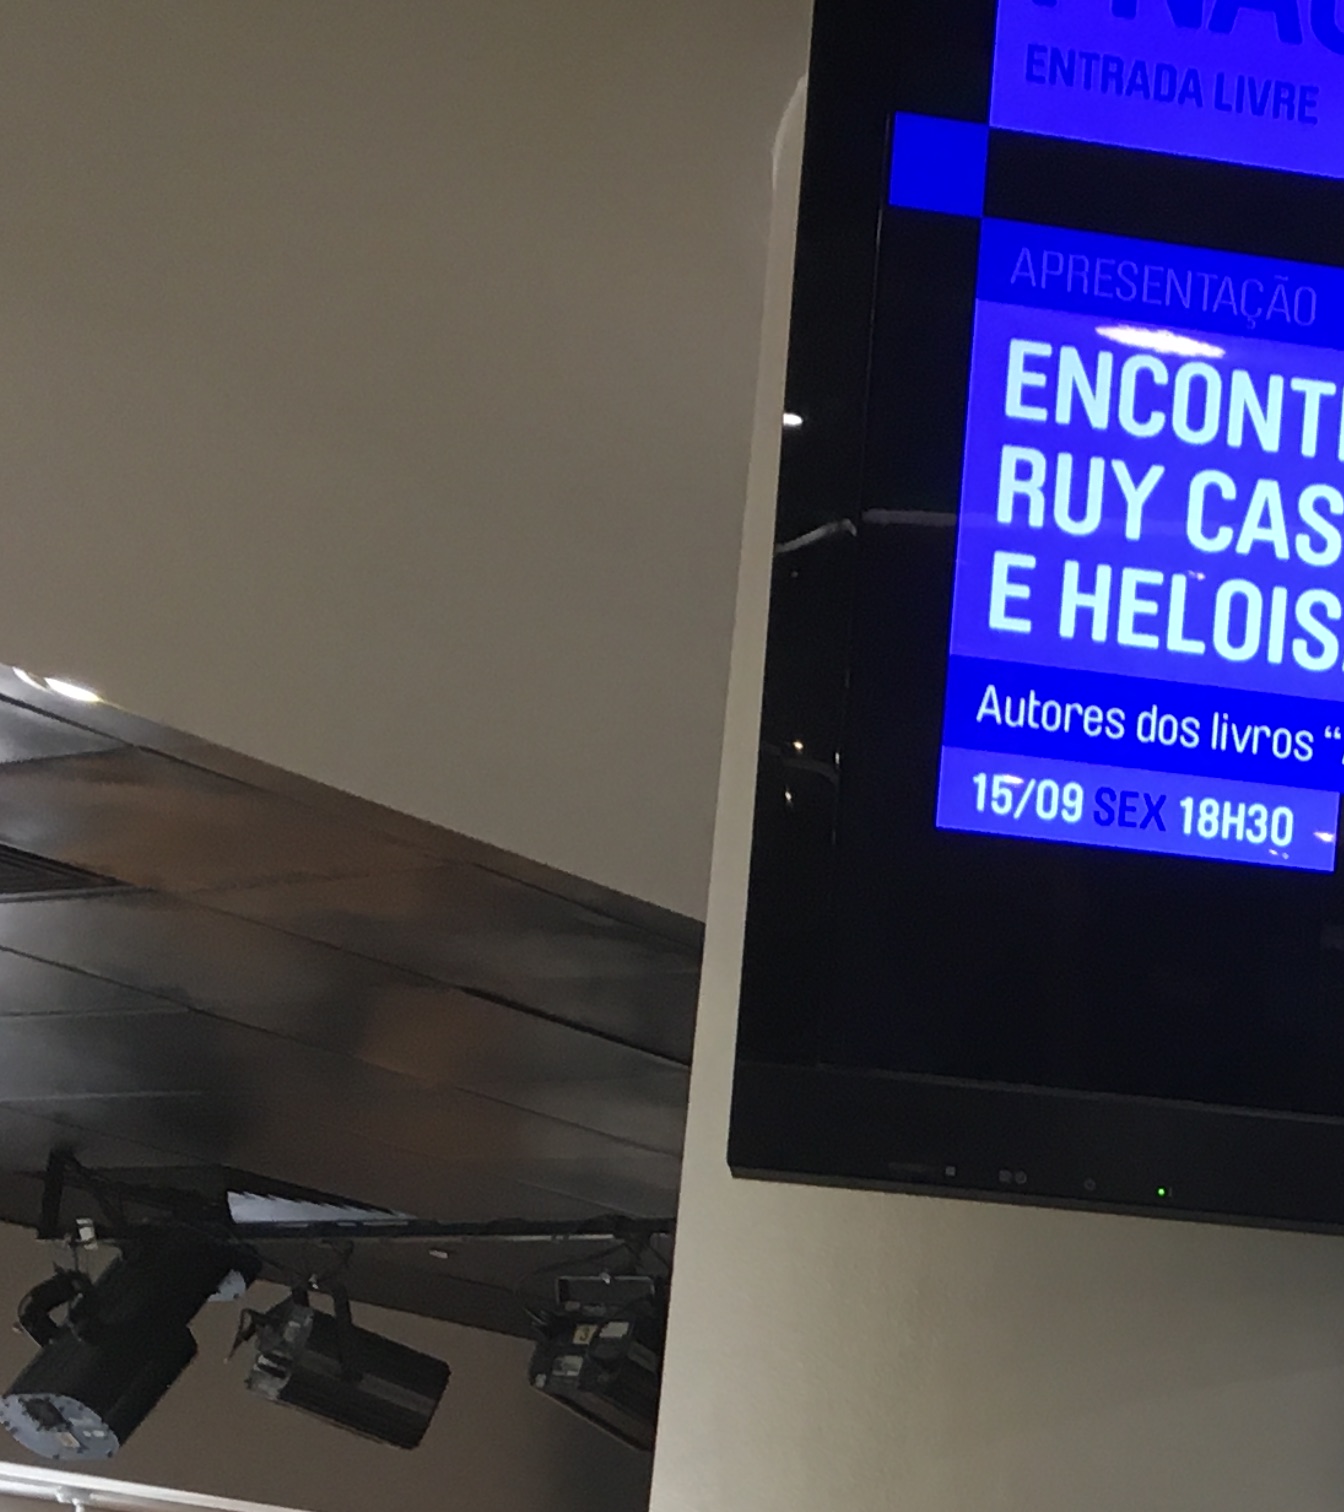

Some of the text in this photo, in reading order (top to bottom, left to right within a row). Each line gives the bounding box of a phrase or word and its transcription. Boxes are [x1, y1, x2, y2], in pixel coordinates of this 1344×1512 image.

[1025, 43, 1320, 126] ENTRADA LIVRE
[1010, 246, 1318, 330] APRESENTAÇÃO
[995, 443, 1166, 542] RUY
[987, 549, 1038, 635] E
[975, 683, 1126, 740] Autores
[1135, 703, 1201, 749] dos
[1210, 711, 1315, 763] livros
[972, 771, 1295, 849] 15/09 SEX 18H30
